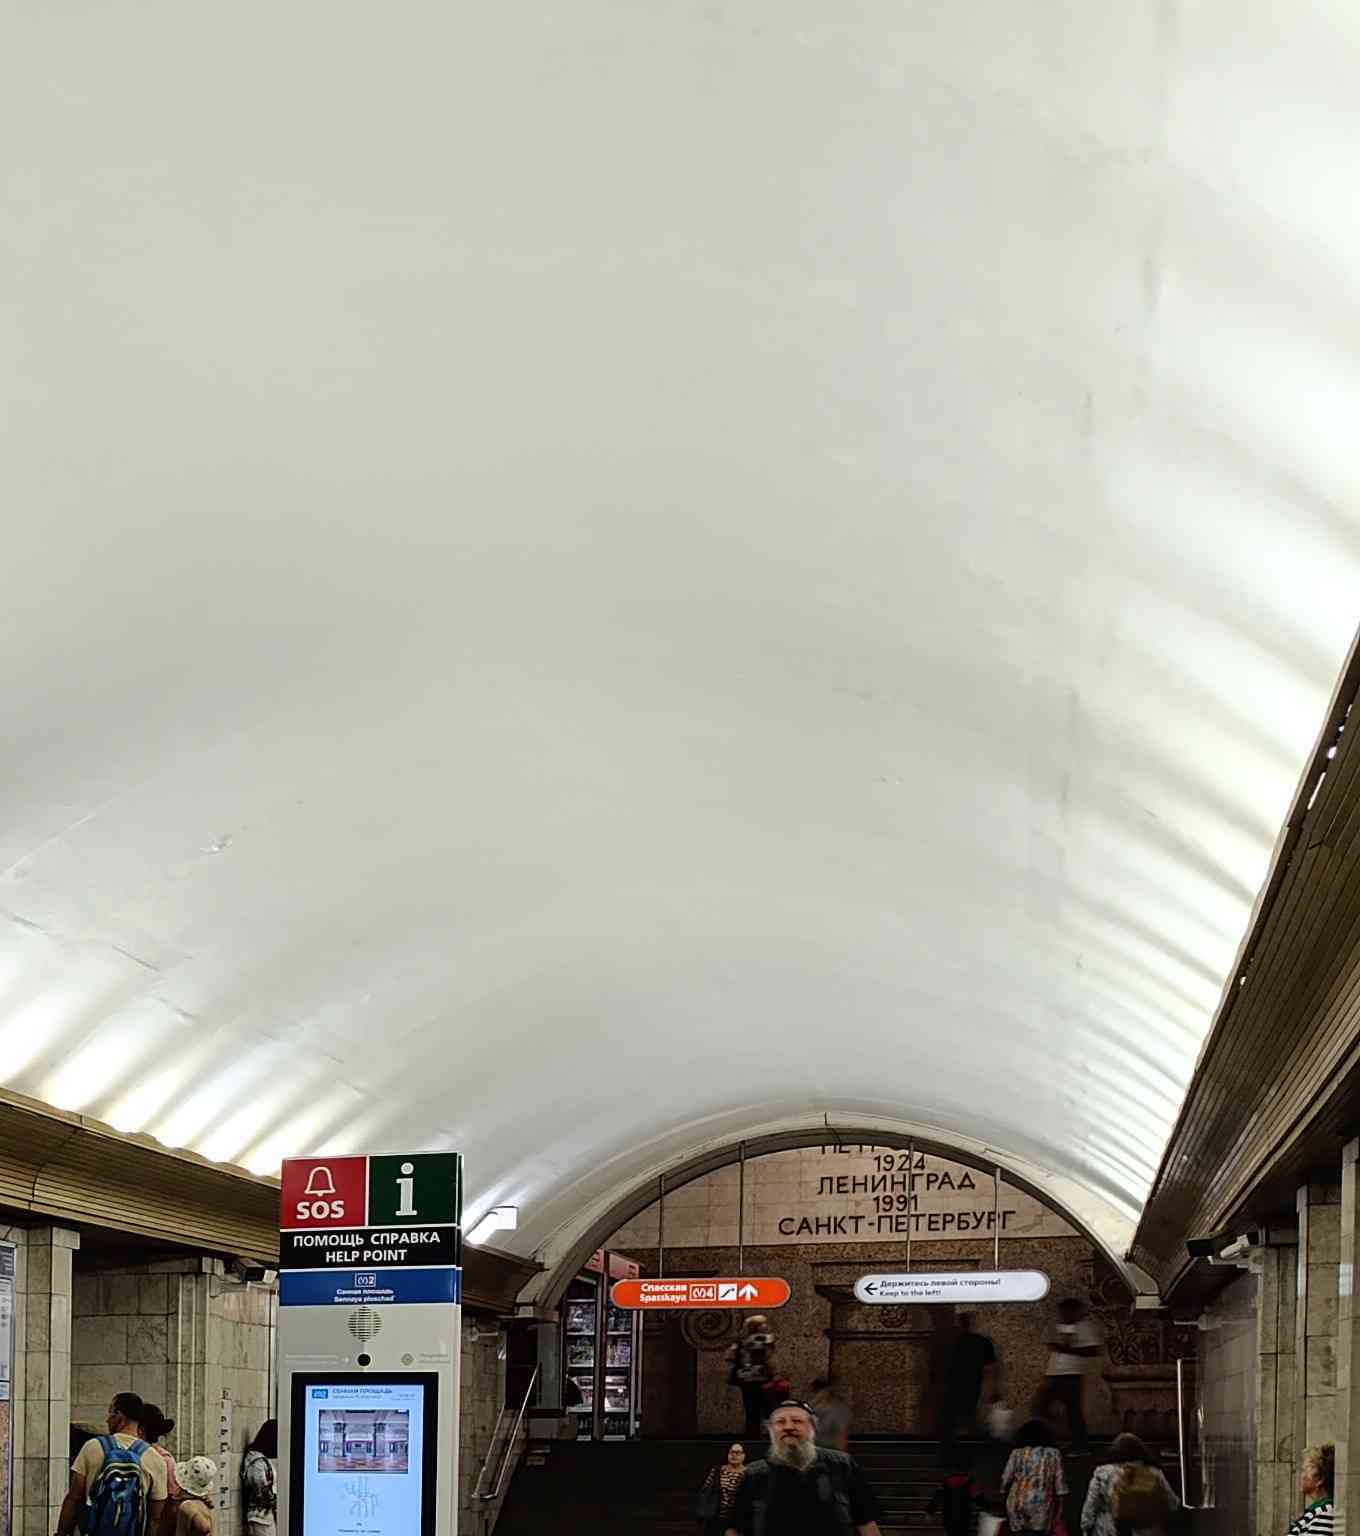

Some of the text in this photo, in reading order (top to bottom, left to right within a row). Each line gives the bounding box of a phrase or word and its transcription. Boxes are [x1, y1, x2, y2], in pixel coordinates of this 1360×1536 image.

[874, 1154, 926, 1172] 1924
[817, 1171, 976, 1195] ЛЕНИНГРАД
[295, 1200, 345, 1220] SOS
[872, 1194, 919, 1213] 1991
[778, 1211, 1017, 1236] САНКТ-ПЕТЕРБУРГ
[293, 1231, 441, 1248] ПОМОЩЬ СПРАВКА
[325, 1249, 408, 1263] HELP POINT
[880, 1279, 929, 1288] Держитесь
[930, 1278, 958, 1287] левой
[639, 1293, 687, 1304] Spasskaya
